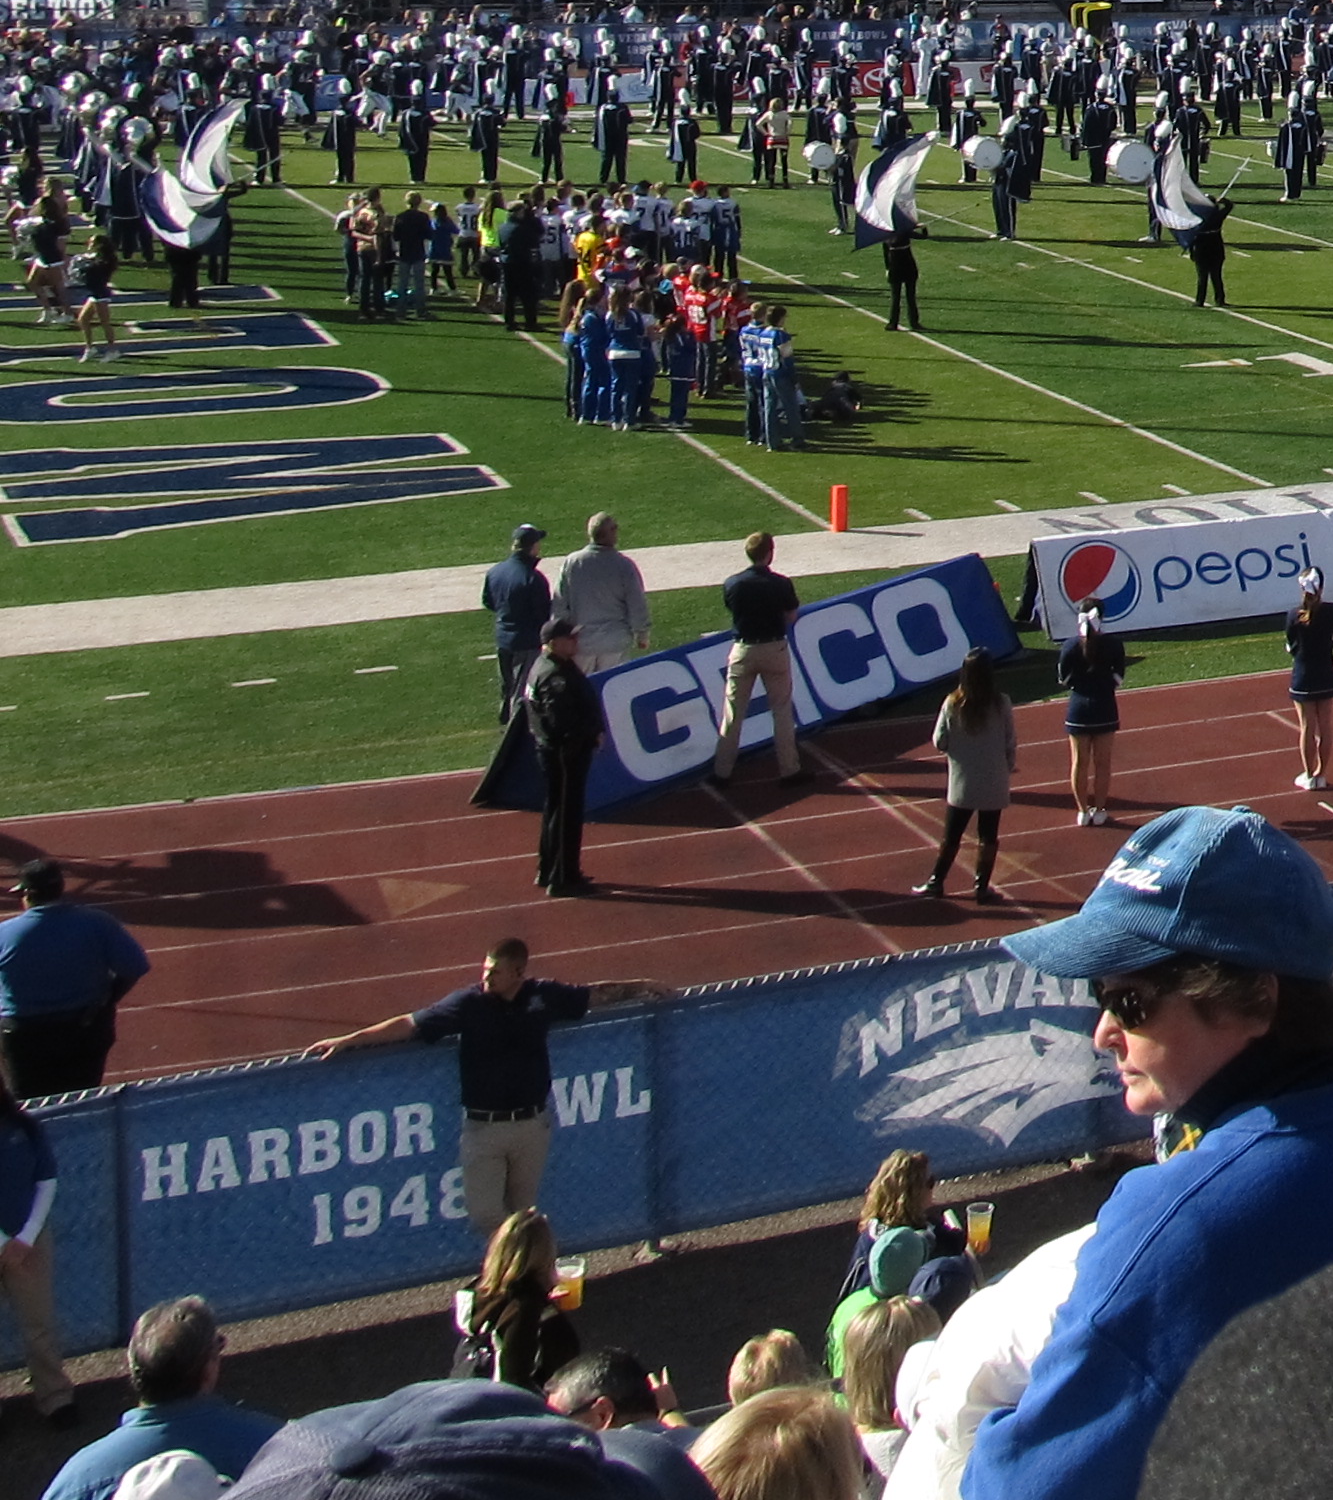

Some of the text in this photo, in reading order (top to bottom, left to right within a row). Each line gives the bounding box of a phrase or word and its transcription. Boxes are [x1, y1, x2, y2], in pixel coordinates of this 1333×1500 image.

[1155, 531, 1312, 604] pepsi
[141, 1066, 652, 1202] HARBOR WL
[311, 1166, 468, 1246] 1948
